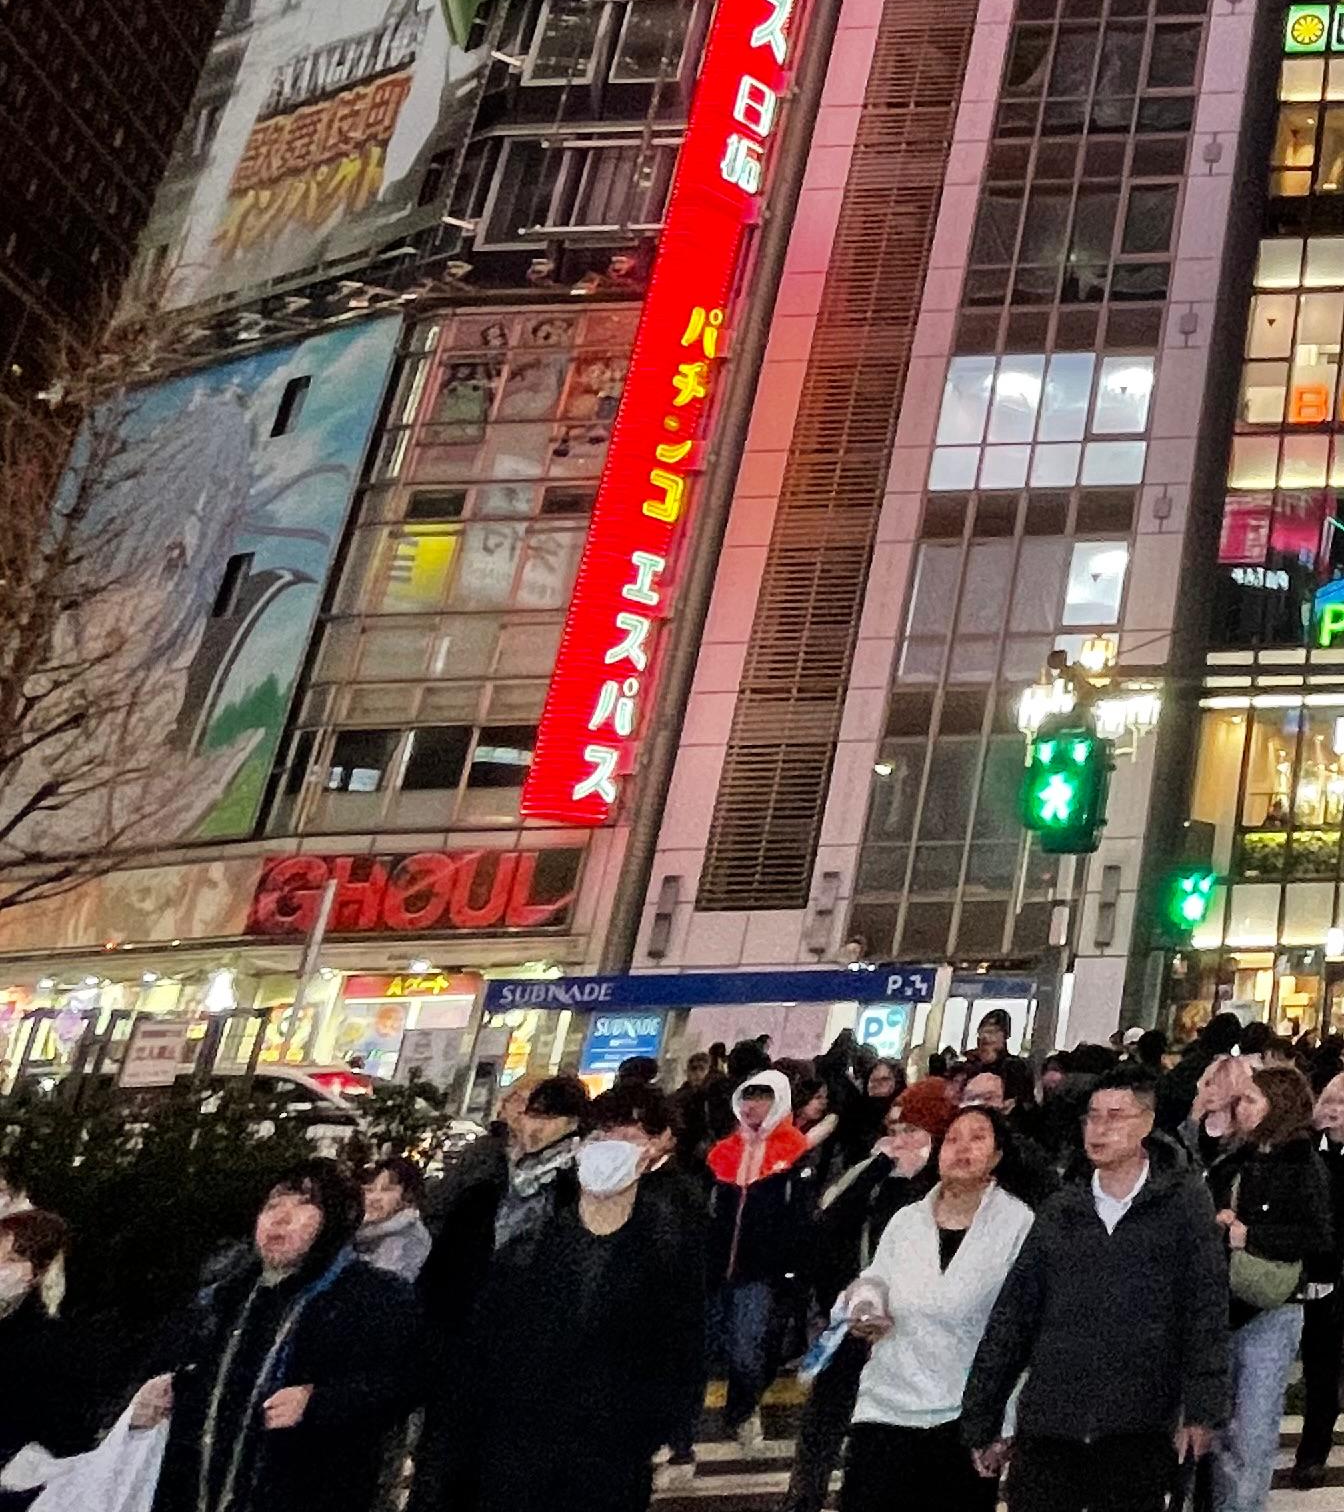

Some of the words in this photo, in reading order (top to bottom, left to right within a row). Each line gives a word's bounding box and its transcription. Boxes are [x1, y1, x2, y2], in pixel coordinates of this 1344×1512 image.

[642, 307, 723, 524] パチンコ
[572, 550, 665, 806] エスパス
[499, 982, 613, 1005] SUBNADE
[864, 1017, 885, 1040] P
